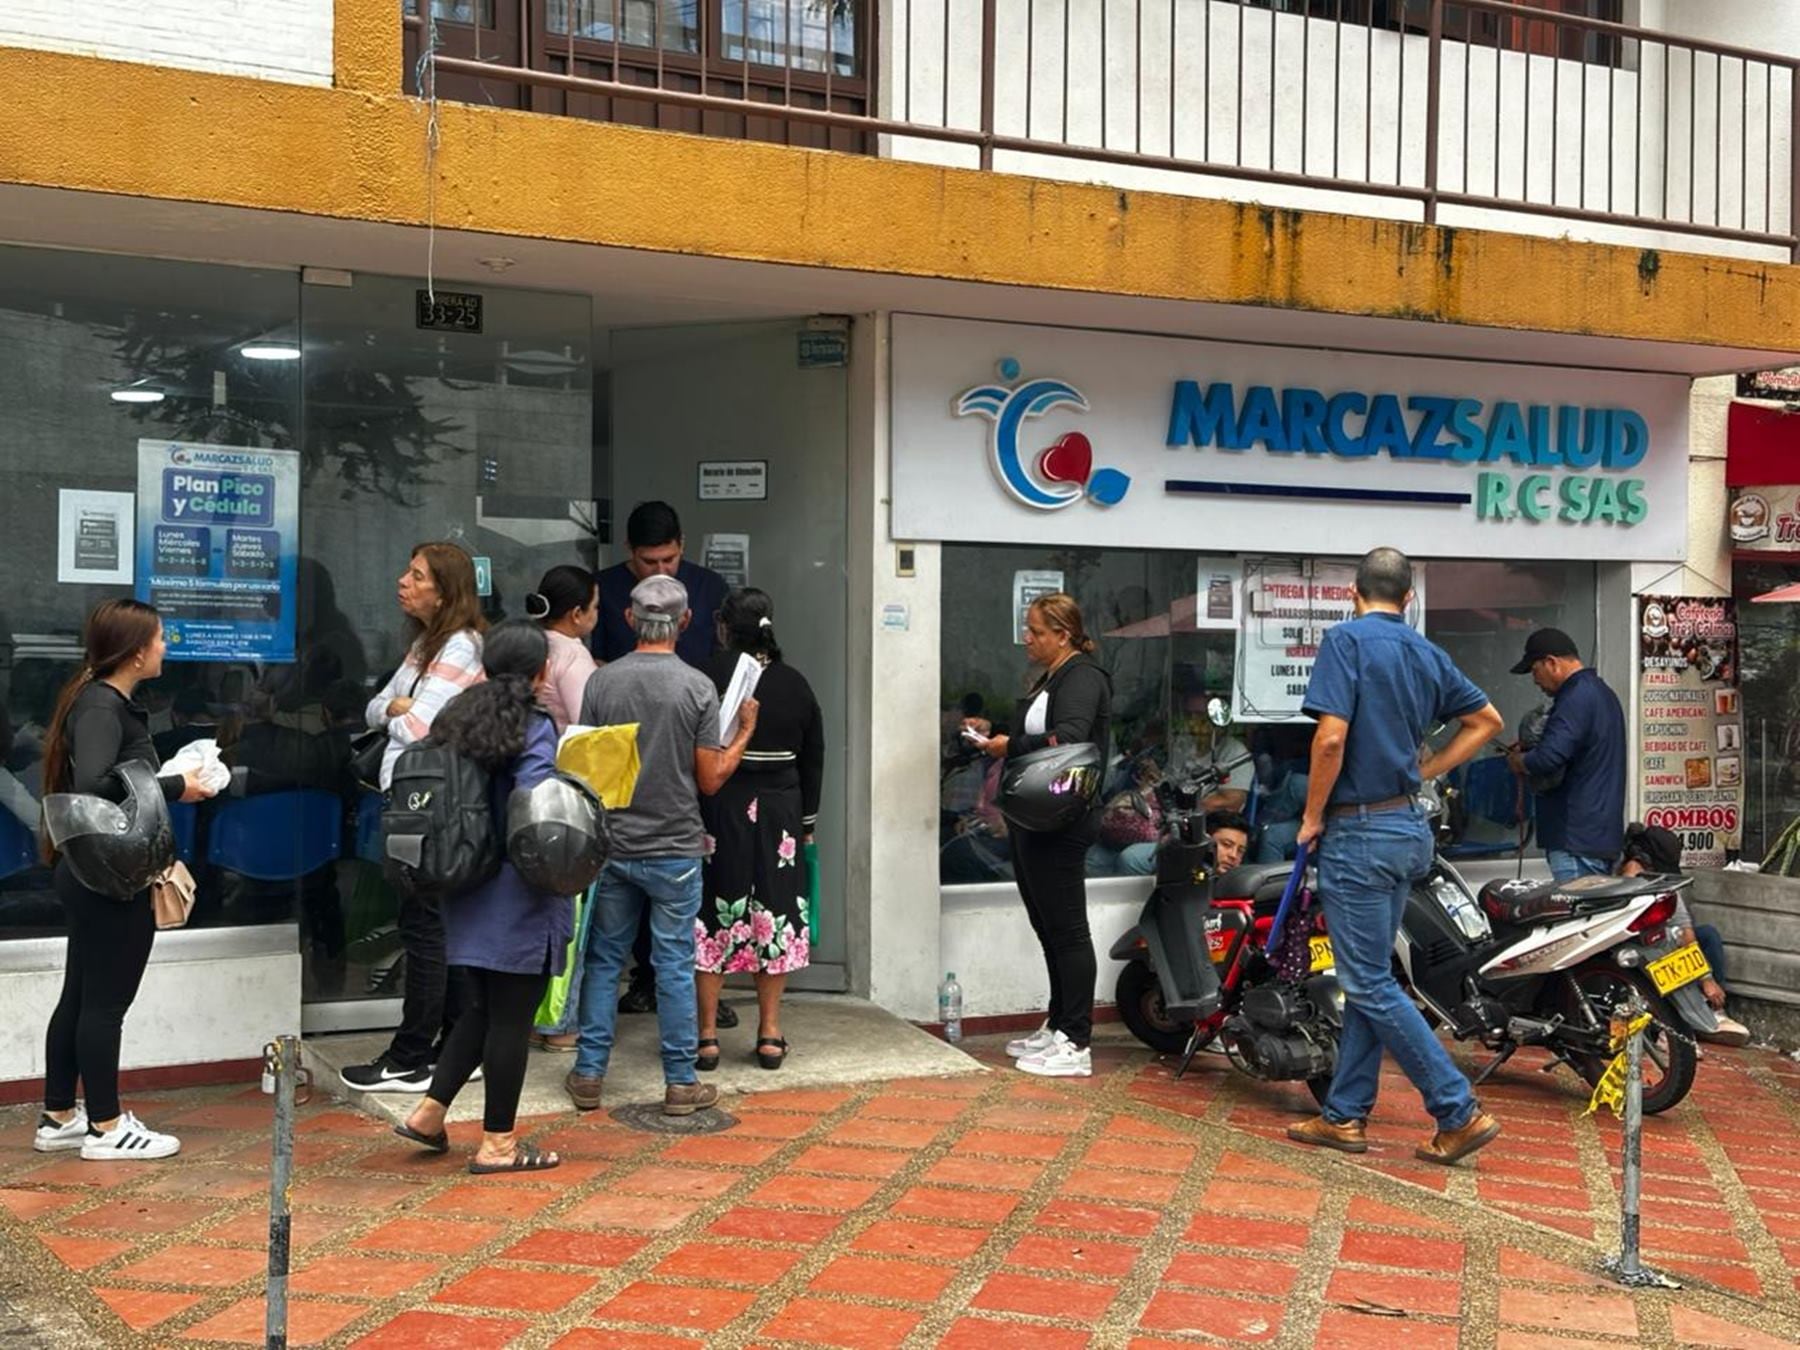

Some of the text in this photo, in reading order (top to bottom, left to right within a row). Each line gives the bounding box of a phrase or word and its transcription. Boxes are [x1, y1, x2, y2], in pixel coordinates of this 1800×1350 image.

[423, 303, 477, 326] 33-25
[1166, 379, 1651, 472] MARCAZSALUD
[193, 453, 274, 466] MARCAZSALUD
[173, 475, 265, 497] Plan Pico
[172, 494, 262, 516] y Cédula
[1559, 475, 1649, 527] SAS
[157, 530, 185, 539] Lunes
[231, 534, 262, 543] Martes
[158, 538, 200, 548] Miércoles
[158, 546, 192, 555] Viernes
[151, 576, 188, 588] Máximo
[1307, 586, 1319, 600] DE
[1644, 656, 1688, 668] DESAYUNOS
[1271, 664, 1295, 677] LUNES
[1297, 665, 1303, 677] A
[1645, 674, 1680, 684] TAMALES
[1286, 684, 1307, 696] SABA
[1645, 707, 1708, 718] CAFE AMERICANO
[1644, 741, 1707, 752] BEBIDAS DE CAFE
[1645, 775, 1684, 785] SANDWICH
[1645, 805, 1739, 832] COMBOS
